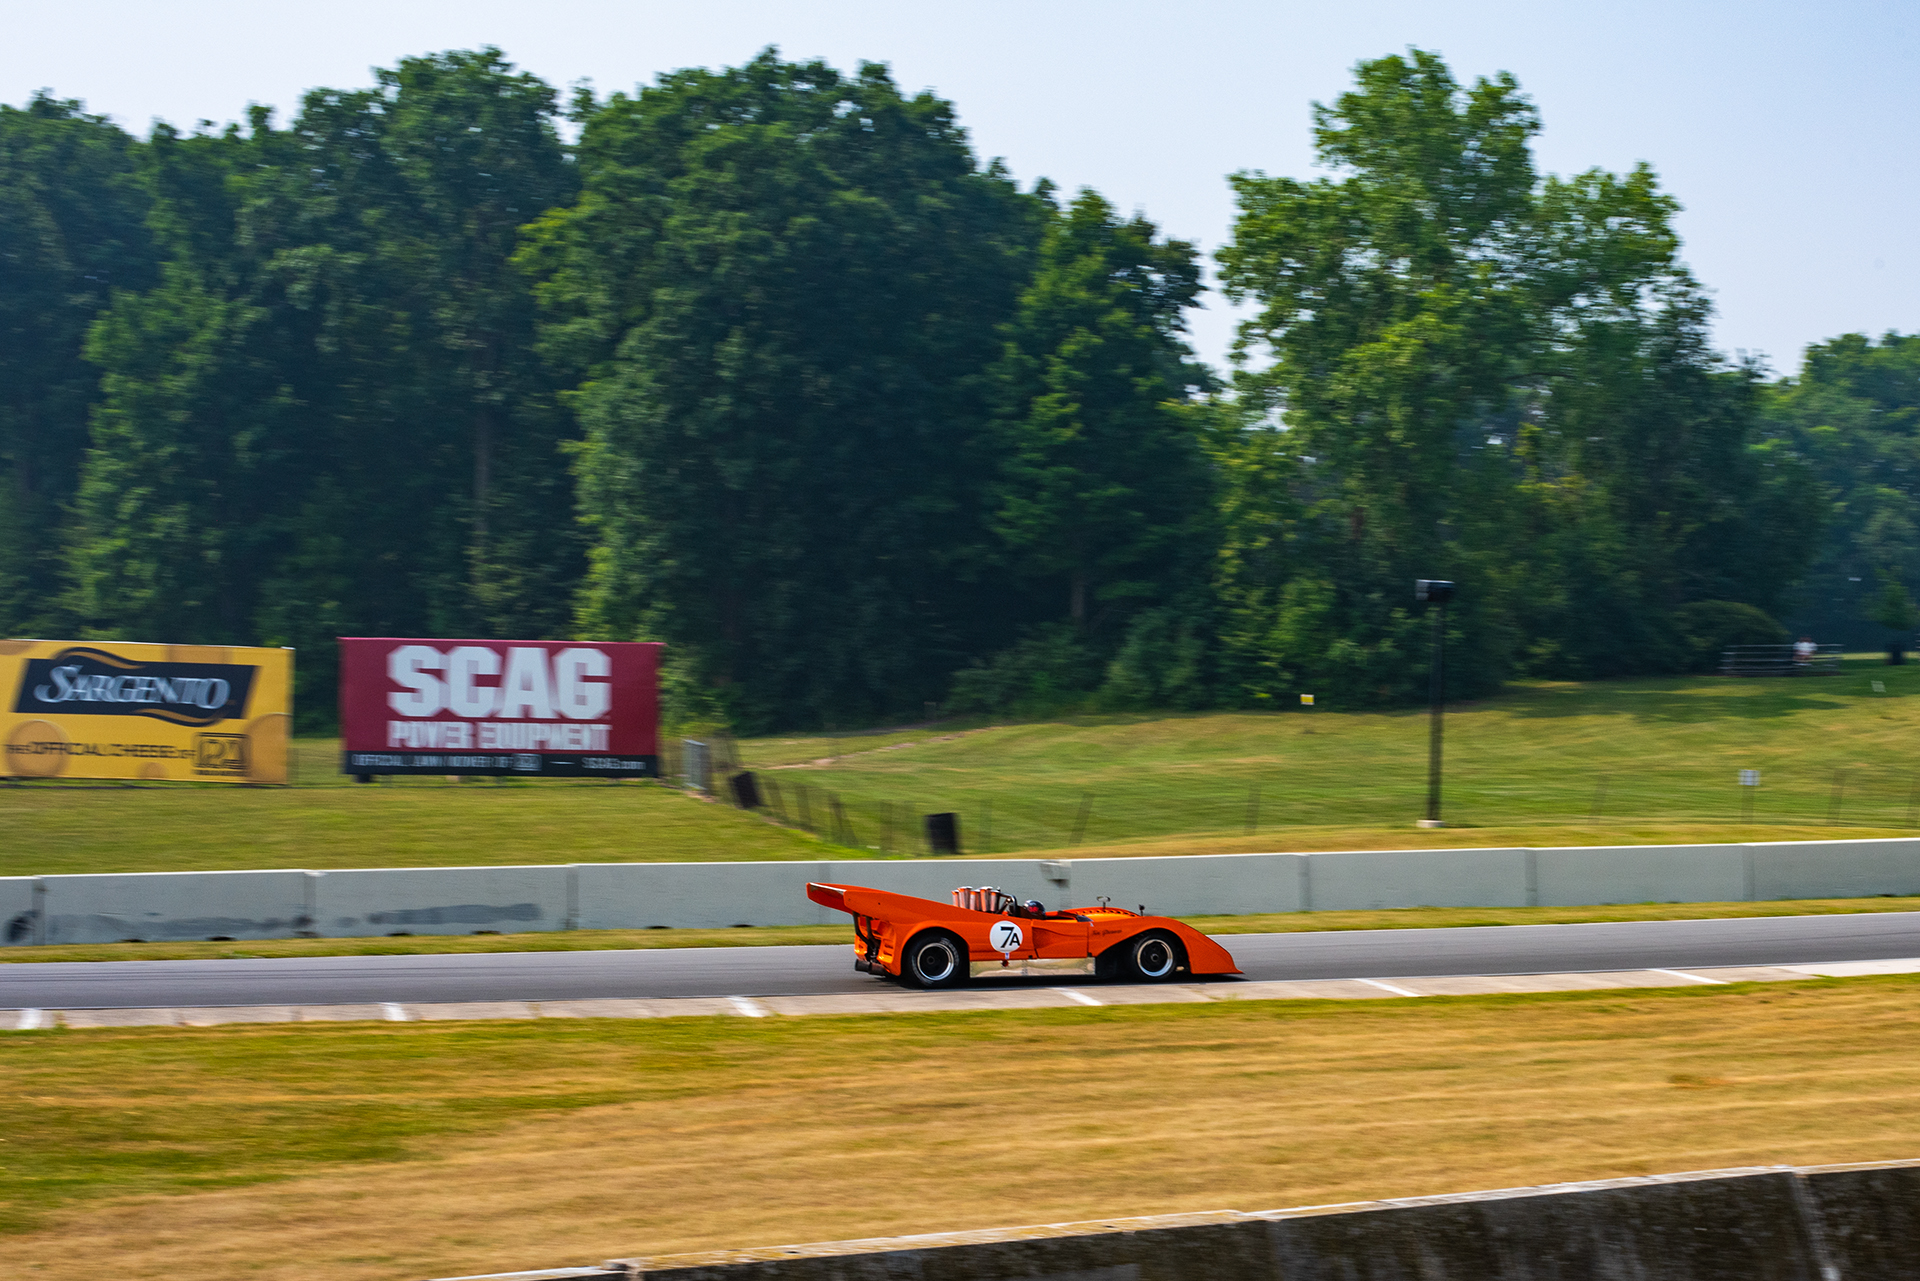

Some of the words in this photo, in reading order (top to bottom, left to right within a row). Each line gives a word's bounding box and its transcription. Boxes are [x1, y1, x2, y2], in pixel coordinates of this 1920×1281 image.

[386, 644, 612, 720] SCAG
[387, 720, 475, 749] POWER
[477, 721, 612, 751] EQUIPMENT
[106, 744, 178, 759] CHEESE
[999, 925, 1021, 949] 7A
